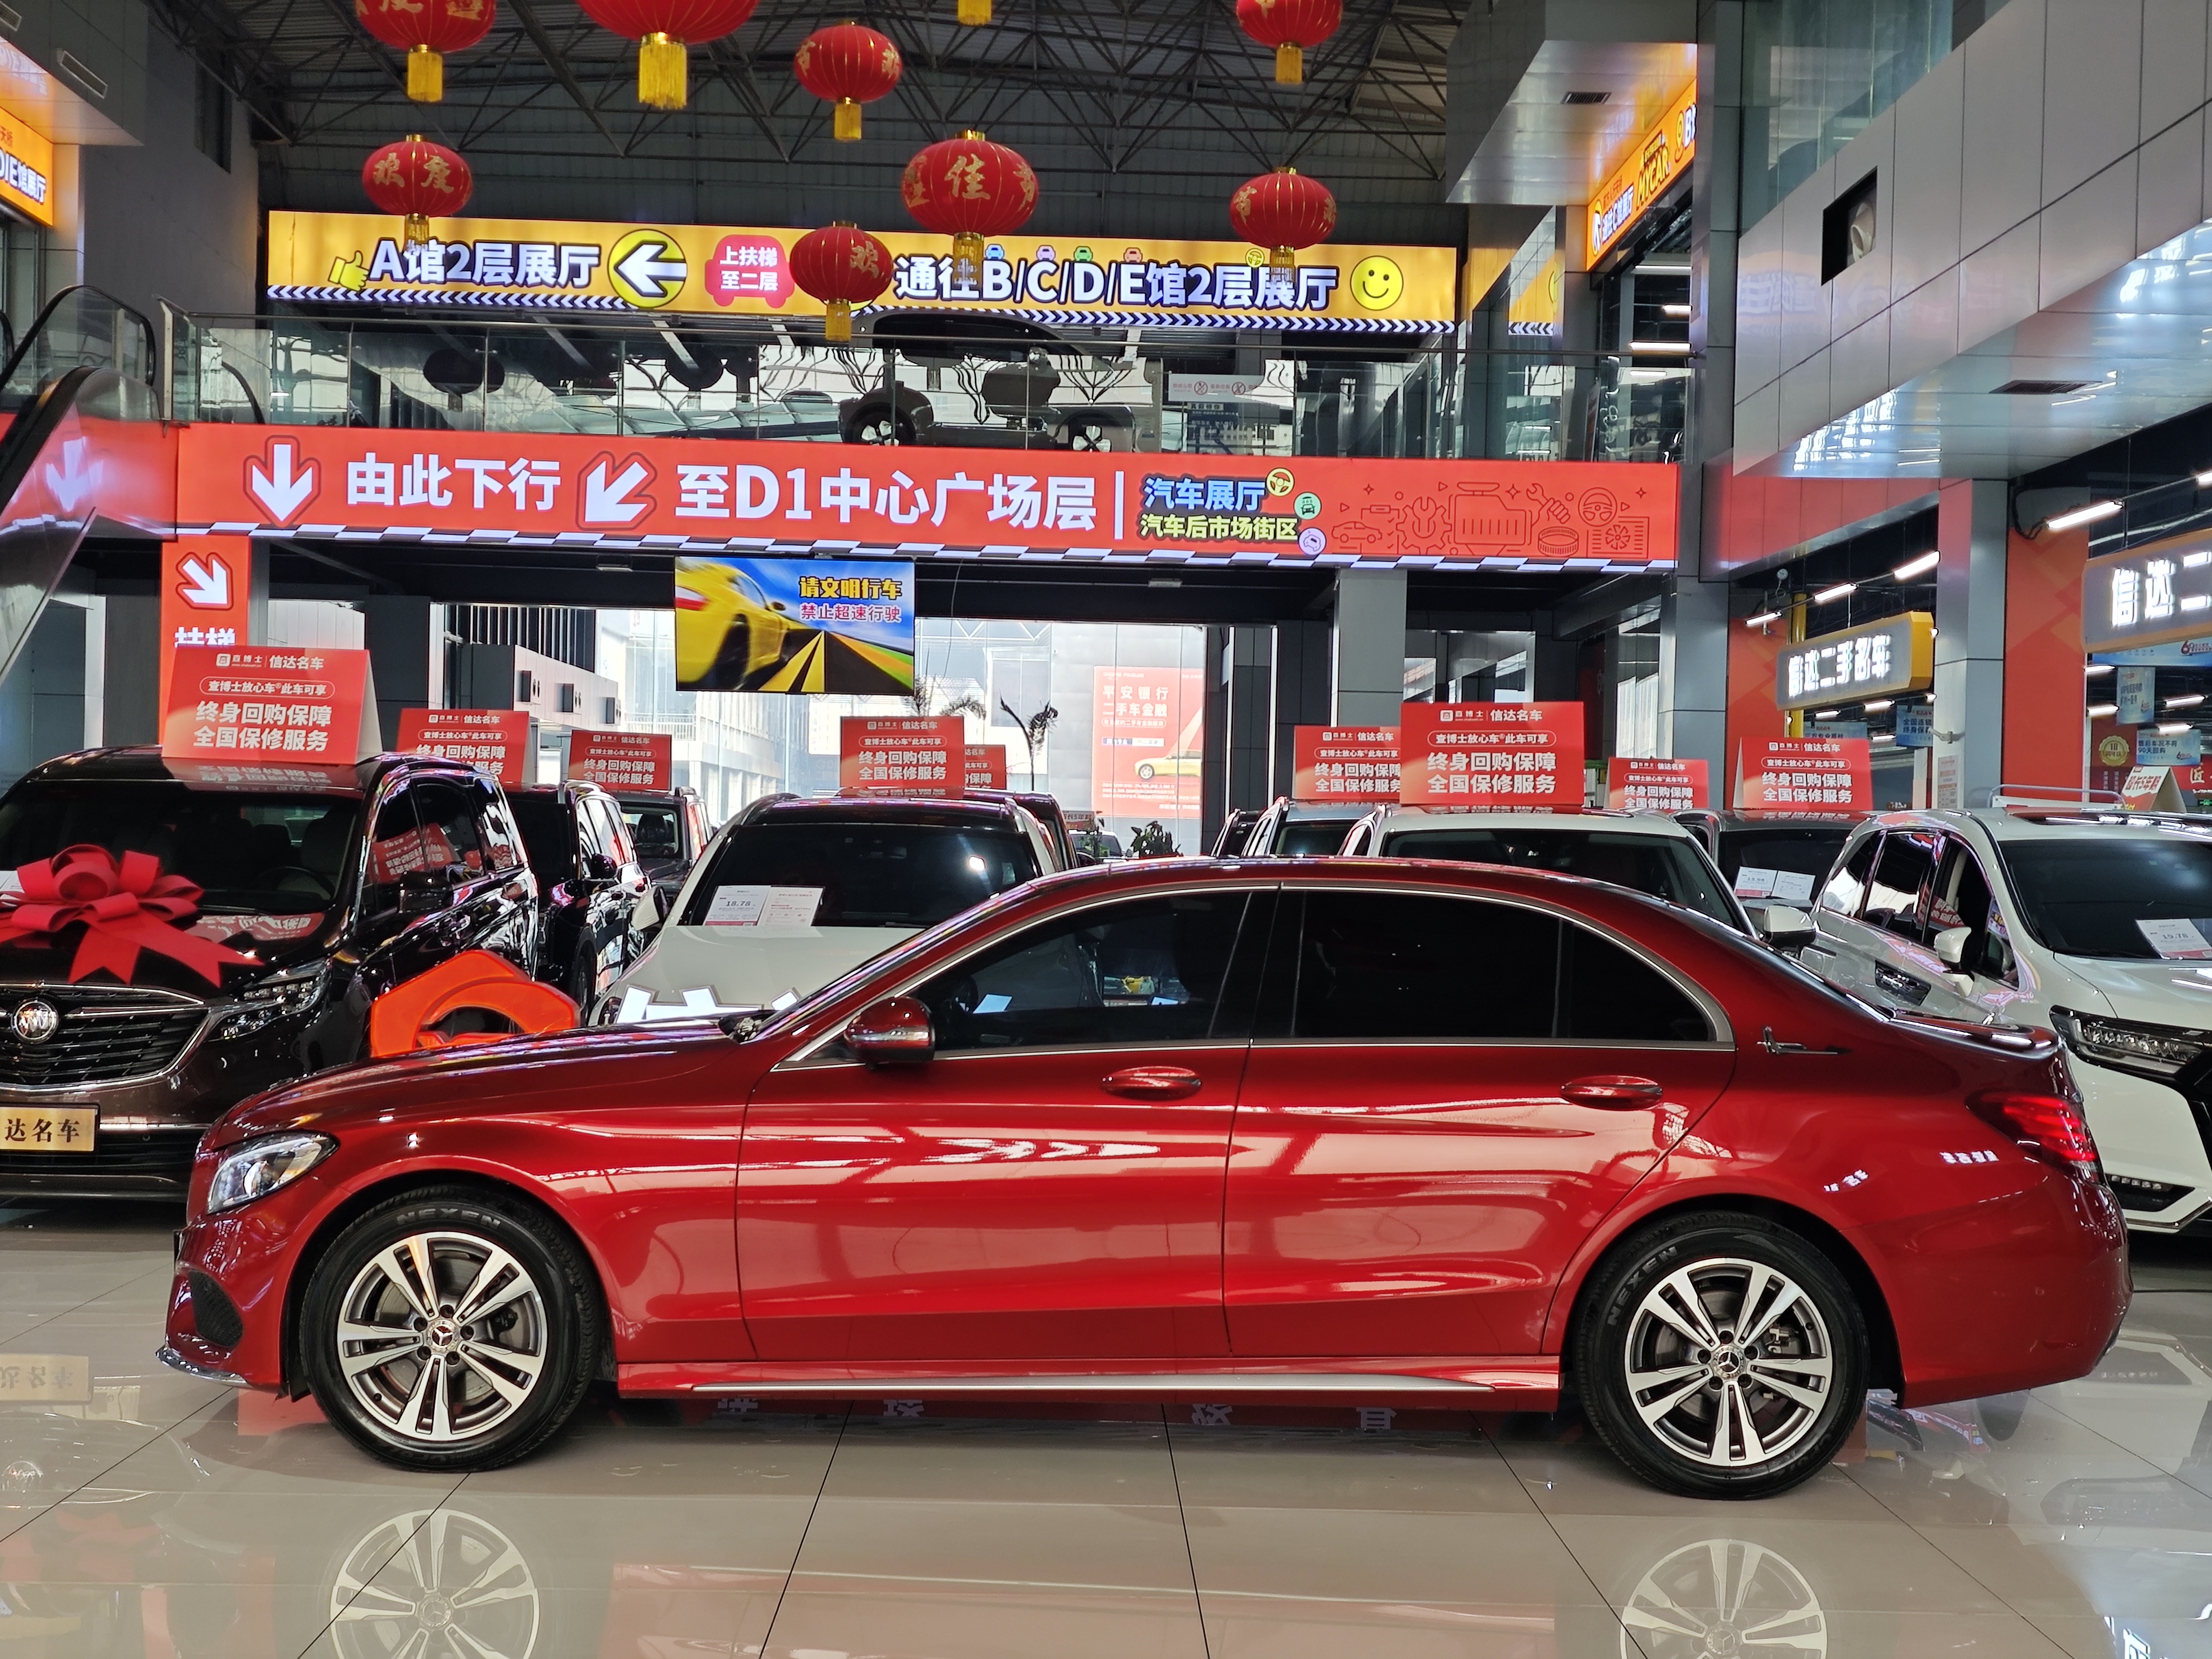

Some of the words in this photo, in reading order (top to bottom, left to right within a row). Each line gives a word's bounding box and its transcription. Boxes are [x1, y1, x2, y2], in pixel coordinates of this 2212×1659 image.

[1637, 147, 1670, 211] MYCAR
[369, 239, 600, 287] A馆2层展厅
[719, 246, 777, 265] 上扶梯
[720, 271, 778, 292] 至二层
[347, 452, 561, 510] 由此下行
[675, 464, 1096, 530] 至D1中心广场层
[1144, 478, 1265, 511] 汽车展厅
[1140, 514, 1298, 540] 汽车后市场街区
[800, 577, 902, 599] 请文明行车
[2112, 551, 2212, 626] 信达二
[800, 603, 901, 622] 禁止超速行驶
[269, 655, 324, 670] 信达名车
[1789, 634, 1891, 697] 信达二手名车
[1103, 685, 1169, 700] 平安银行
[195, 700, 332, 727] 终身回购保障
[1102, 703, 1167, 717] 二手车金融
[1490, 710, 1542, 721] 信达名车
[464, 715, 500, 724] 信达名车
[902, 721, 938, 730] 信达名车
[193, 725, 329, 752] 全国保修服务
[1358, 732, 1394, 741] 信达名车
[416, 744, 506, 759] 终身回购保障
[1804, 742, 1840, 752] 信达名车
[584, 758, 655, 772] 终身回购保障
[858, 751, 947, 765] 终身回购保障
[1427, 752, 1556, 772] 终身回购保障
[583, 771, 654, 785] 全国保修服务
[859, 766, 947, 780] 全国保修服务
[1314, 763, 1401, 777] 终身回购保障
[1315, 778, 1401, 793] 全国保修服务
[1427, 774, 1556, 794] 全国保修服务
[1762, 772, 1852, 788] 终身回购保障
[1624, 785, 1693, 798] 终身回购保障
[1763, 787, 1852, 804] 全国保修服务
[1624, 797, 1693, 810] 全国保修服务
[5, 1118, 80, 1143] 达名车
[397, 1208, 501, 1229] NEXEN
[1607, 1246, 1677, 1326] NEXEN
